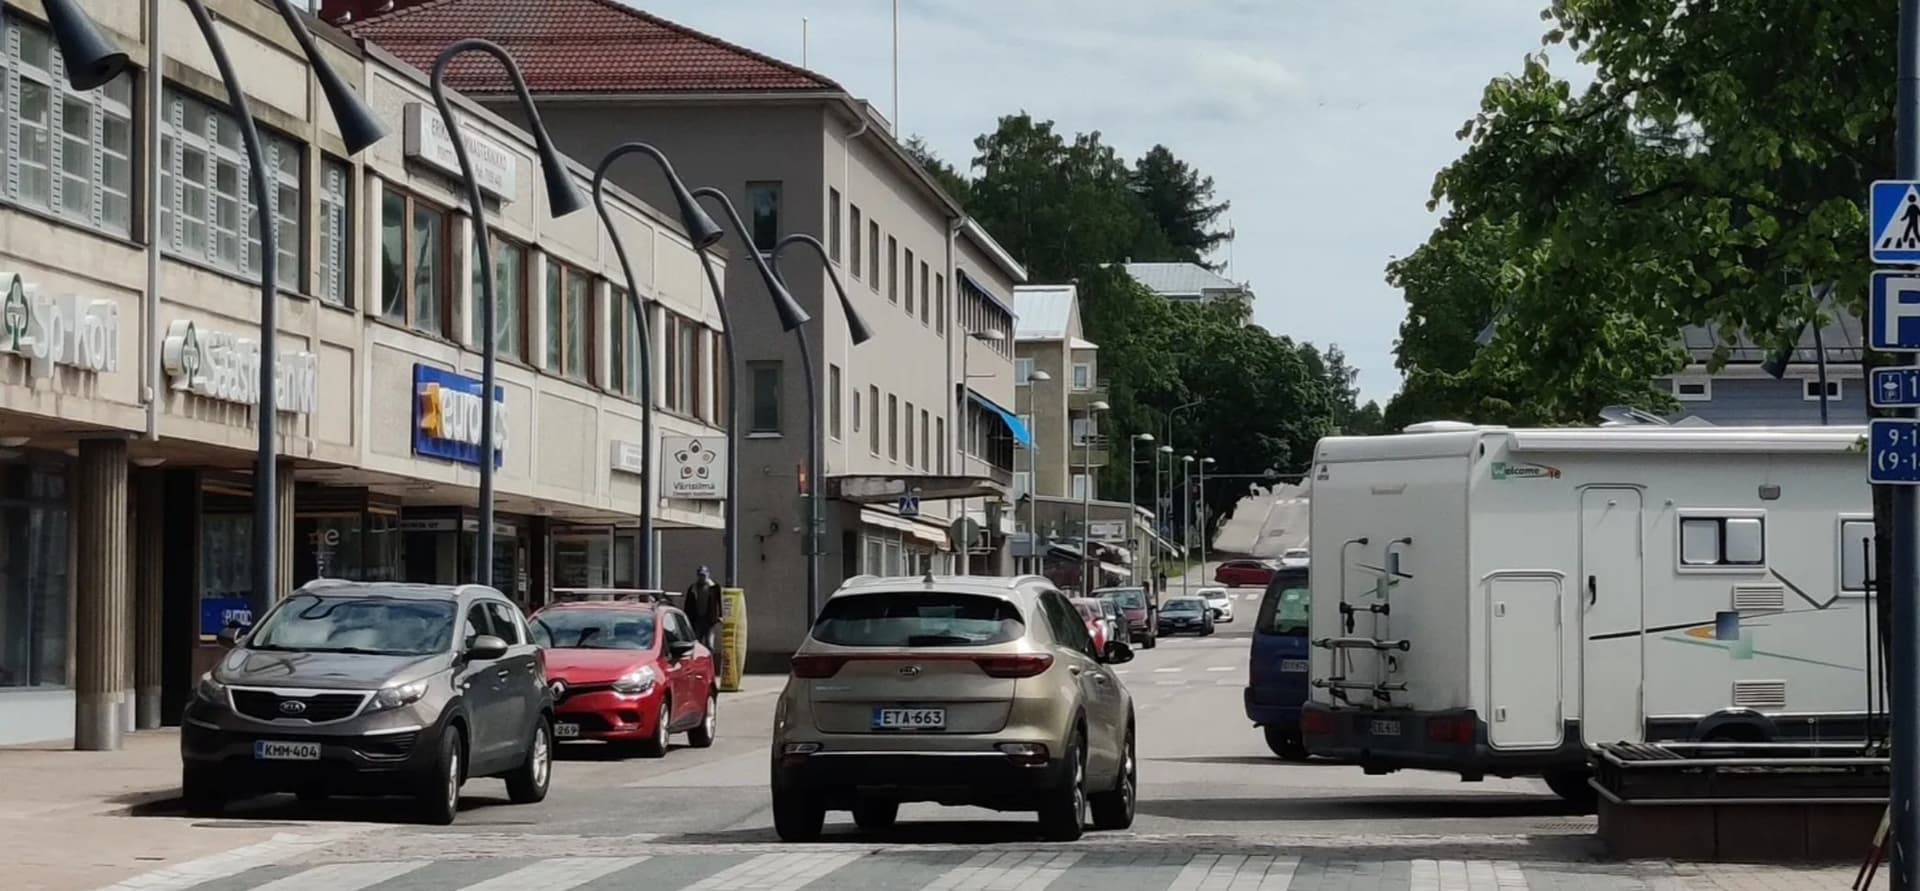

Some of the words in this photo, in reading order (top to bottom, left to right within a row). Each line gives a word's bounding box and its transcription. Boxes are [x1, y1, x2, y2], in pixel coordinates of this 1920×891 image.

[26, 287, 120, 378] Sp-Koti
[199, 330, 317, 412] Säästankki
[1888, 429, 1920, 447] 9-1
[1878, 449, 1920, 471] (9-1
[1493, 464, 1540, 476] Welcome
[882, 711, 943, 725] ETA-663
[264, 743, 318, 758] KMM-404
